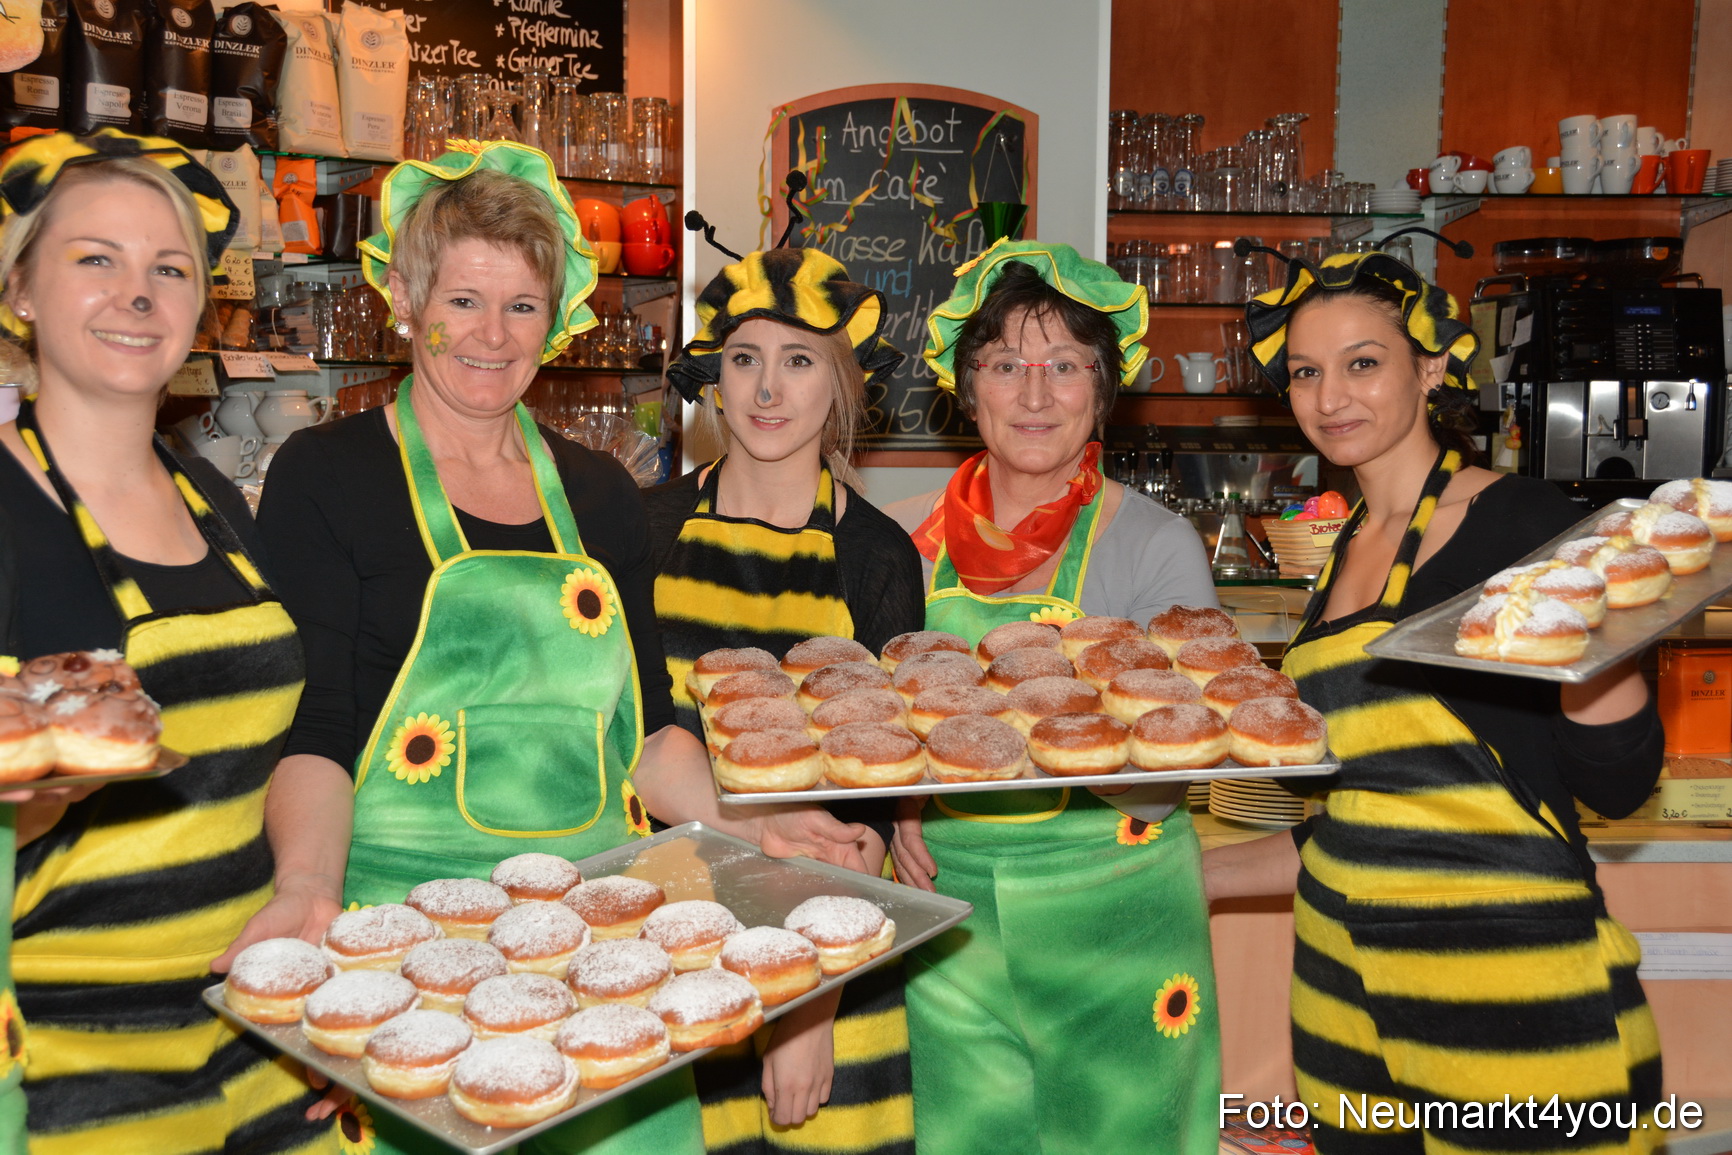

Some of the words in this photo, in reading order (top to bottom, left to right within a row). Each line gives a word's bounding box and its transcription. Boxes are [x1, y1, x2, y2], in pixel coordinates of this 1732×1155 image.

[84, 21, 132, 41] DINZLER
[164, 31, 211, 48] DINZLER
[214, 39, 261, 54] DINZLER
[450, 39, 482, 68] Tee
[351, 56, 396, 70] DINZLER
[564, 54, 599, 80] Tee
[21, 74, 55, 86] Espresso
[26, 85, 50, 96] Roma
[173, 91, 205, 104] Espresso
[218, 98, 247, 109] Espresso
[176, 101, 202, 114] Verona
[221, 108, 242, 118] Brasil
[841, 107, 963, 158] Angebot
[864, 258, 914, 299] und
[1690, 689, 1726, 697] DINZLER
[1662, 808, 1680, 820] 3,20
